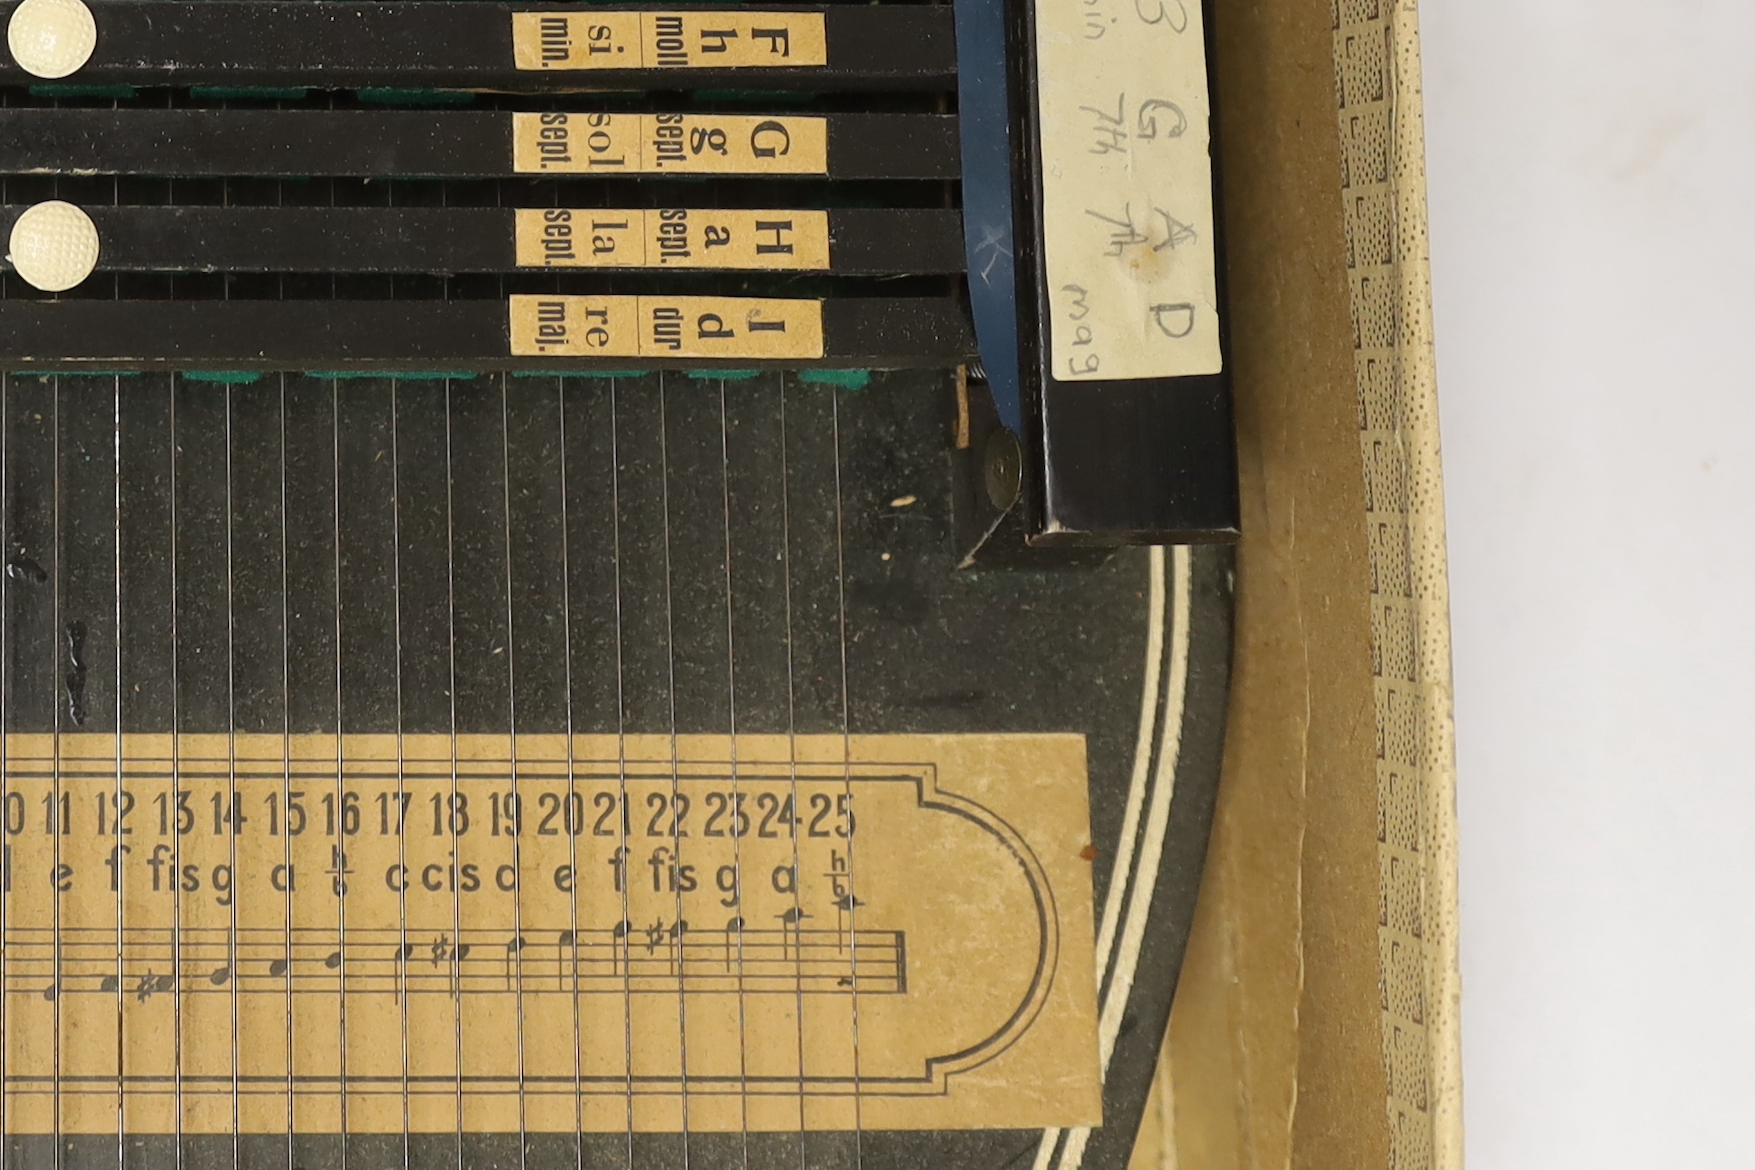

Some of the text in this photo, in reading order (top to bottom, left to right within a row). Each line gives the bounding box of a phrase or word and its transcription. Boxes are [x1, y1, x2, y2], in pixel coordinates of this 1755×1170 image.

[540, 17, 571, 68] min.
[587, 24, 624, 57] si
[655, 15, 688, 66] moll
[700, 28, 738, 53] h
[751, 27, 790, 58] F
[540, 112, 572, 169] sept.
[587, 112, 625, 167] sol
[655, 113, 687, 168] sept.
[750, 120, 790, 160] G
[1079, 92, 1127, 154] 7th
[1138, 99, 1187, 139] G
[690, 128, 727, 156] g
[591, 218, 628, 255] la
[659, 208, 691, 264] sept.
[705, 224, 731, 248] a
[755, 219, 792, 255] H
[1085, 202, 1148, 257] 7th
[1153, 207, 1197, 251] A
[534, 301, 565, 352] maj.
[584, 306, 608, 348] re
[652, 307, 684, 351] dur
[698, 312, 735, 339] d
[1150, 303, 1195, 339] D
[42, 790, 70, 836] 11
[95, 791, 135, 836] 12
[151, 791, 194, 836] 13
[210, 791, 247, 836] 14
[265, 791, 306, 836] 15
[322, 792, 360, 836] 16
[375, 792, 412, 836] 17
[430, 792, 470, 836] 18
[489, 792, 522, 837] 19
[538, 792, 584, 836] 20
[594, 792, 631, 837] 21
[646, 792, 691, 837] 22
[704, 792, 751, 838] 23
[757, 793, 803, 838] 24
[808, 793, 857, 838] 25
[50, 864, 74, 893] e
[105, 844, 132, 892] f
[146, 844, 200, 893] fis
[212, 863, 233, 906] g
[271, 864, 295, 893] a
[385, 864, 410, 893] c
[422, 851, 481, 893] cis
[554, 864, 578, 893] e
[608, 846, 632, 892] f
[648, 846, 698, 893] fis
[715, 865, 740, 908] g
[771, 864, 797, 894] a
